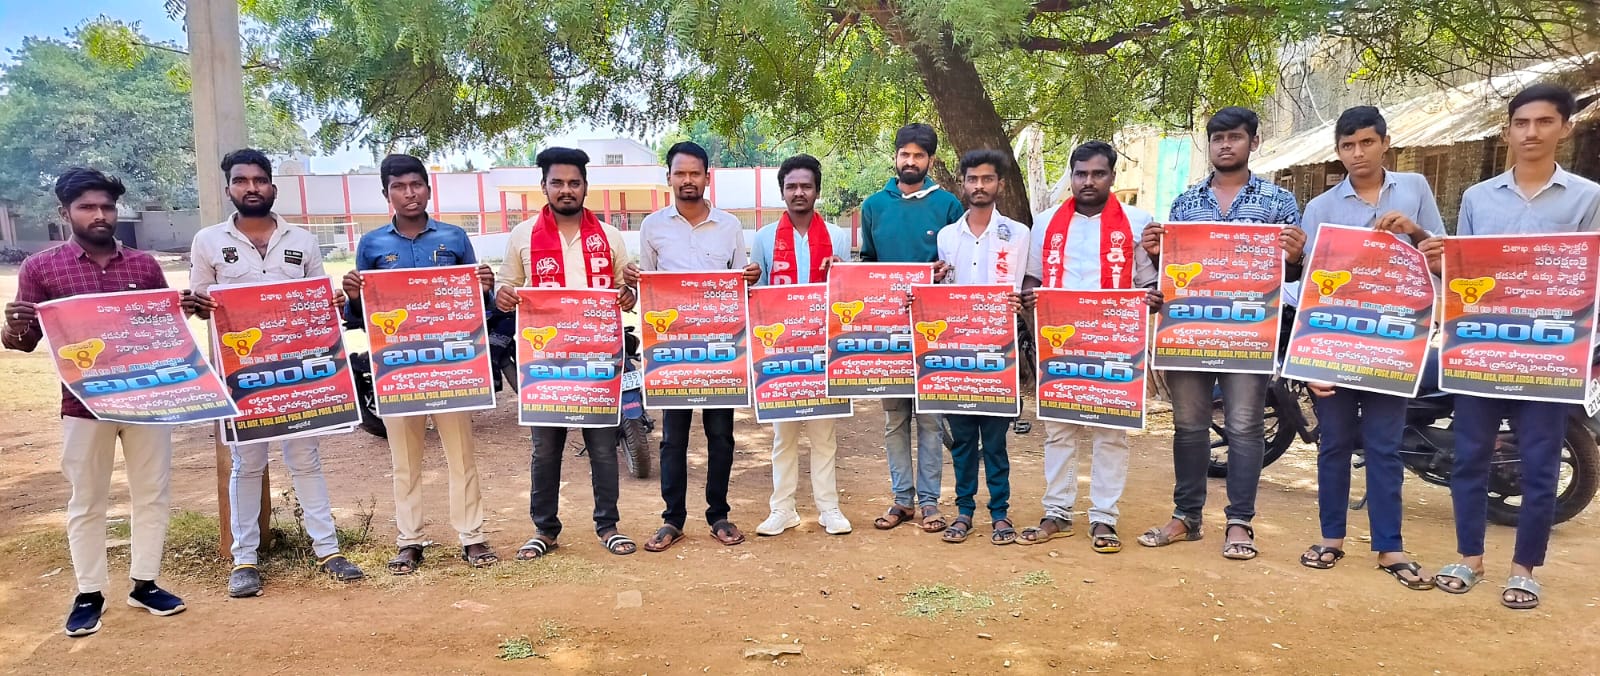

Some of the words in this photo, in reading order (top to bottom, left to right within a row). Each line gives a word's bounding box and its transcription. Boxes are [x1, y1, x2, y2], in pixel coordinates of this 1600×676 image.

[1175, 272, 1188, 288] 8
[1320, 279, 1334, 295] 8
[1463, 287, 1478, 303] 8
[1309, 312, 1417, 338] బంద్
[1456, 319, 1575, 343] బంద్
[237, 340, 250, 356] 8
[237, 355, 336, 388] బంద్
